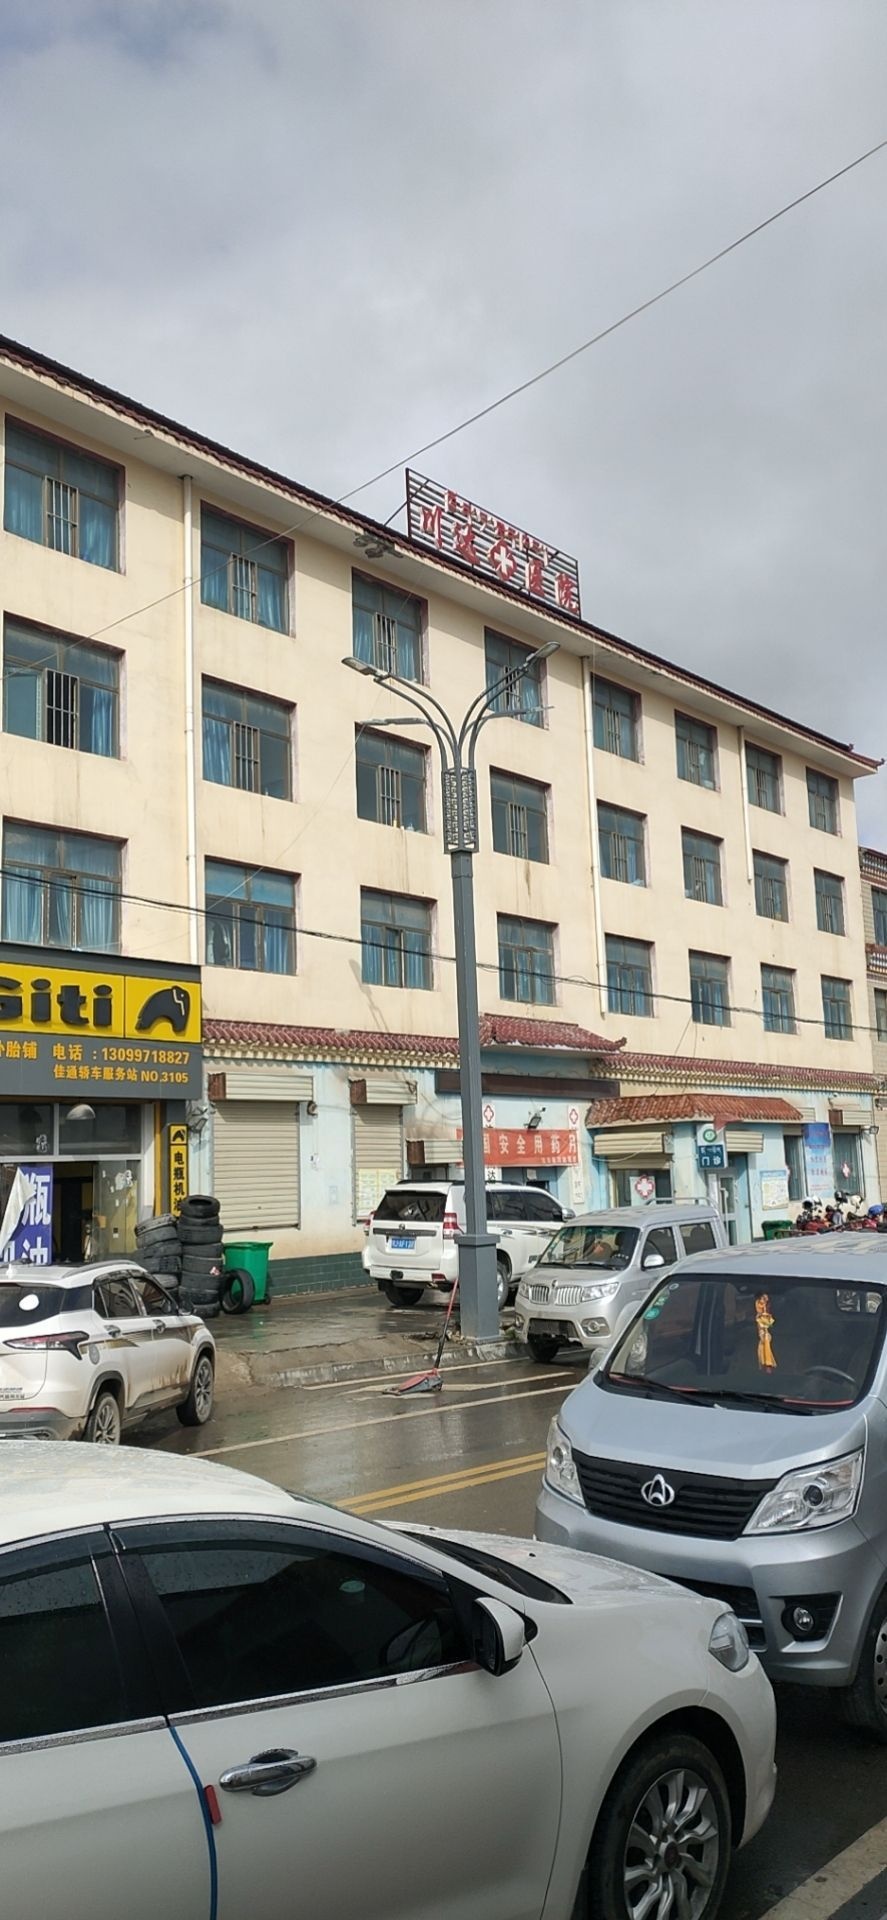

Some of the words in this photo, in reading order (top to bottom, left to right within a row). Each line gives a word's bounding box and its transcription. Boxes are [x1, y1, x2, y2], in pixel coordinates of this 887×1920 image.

[53, 1064, 138, 1081] 佳通轿车服务站
